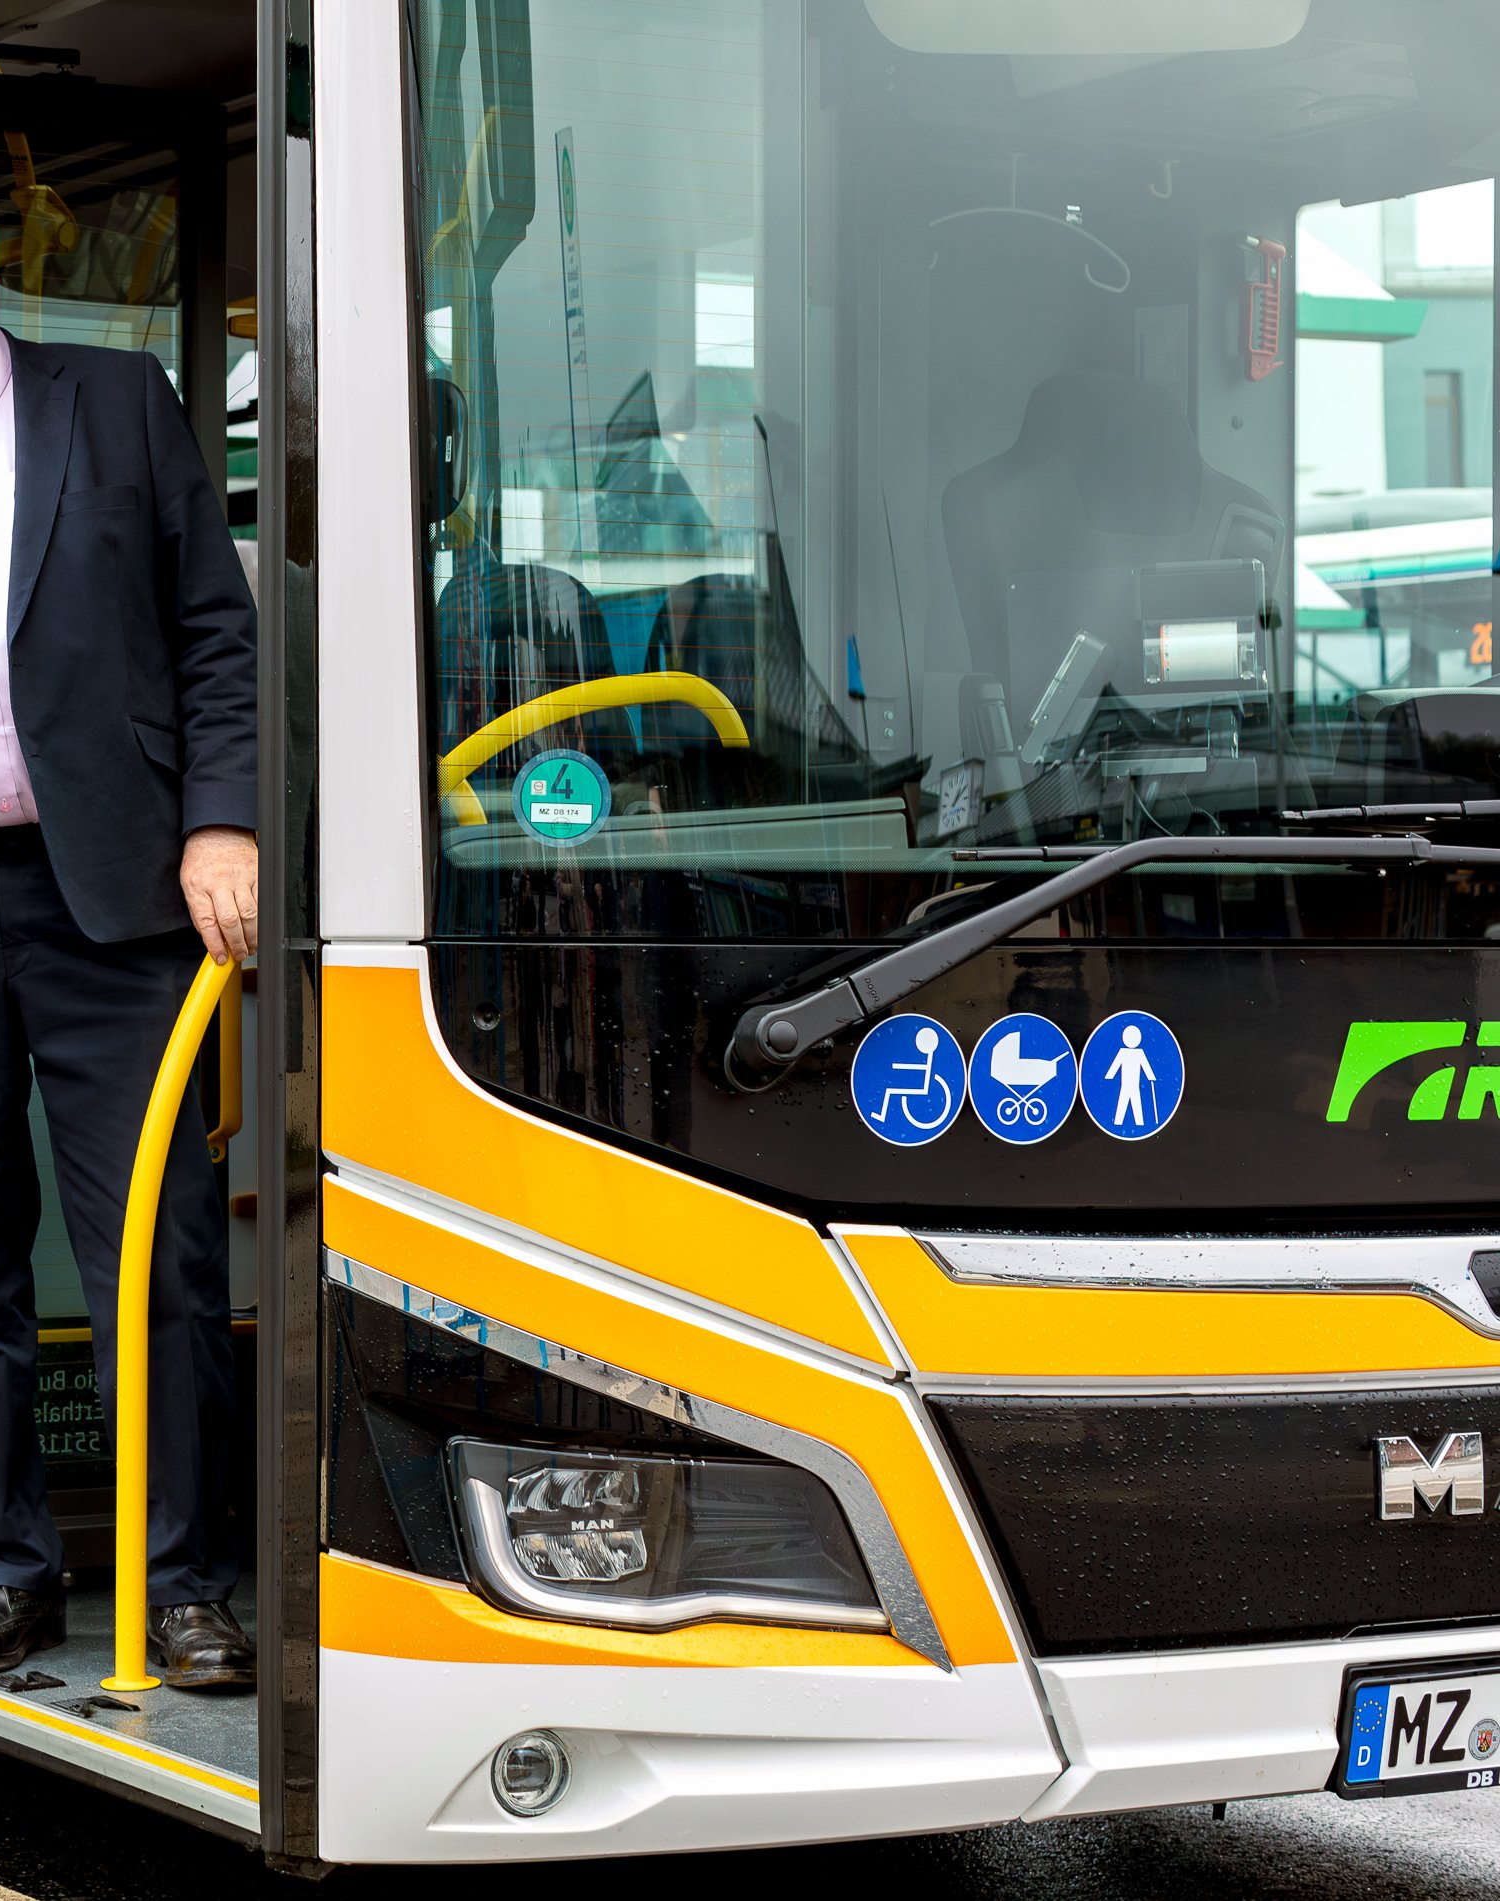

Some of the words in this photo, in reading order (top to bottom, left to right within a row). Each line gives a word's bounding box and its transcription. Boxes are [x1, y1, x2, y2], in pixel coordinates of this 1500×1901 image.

[550, 763, 574, 800] 4
[1375, 1431, 1500, 1520] M
[571, 1519, 615, 1531] MAN
[1387, 1688, 1472, 1768] MZ
[1356, 1745, 1371, 1767] D
[1466, 1770, 1494, 1788] DB
